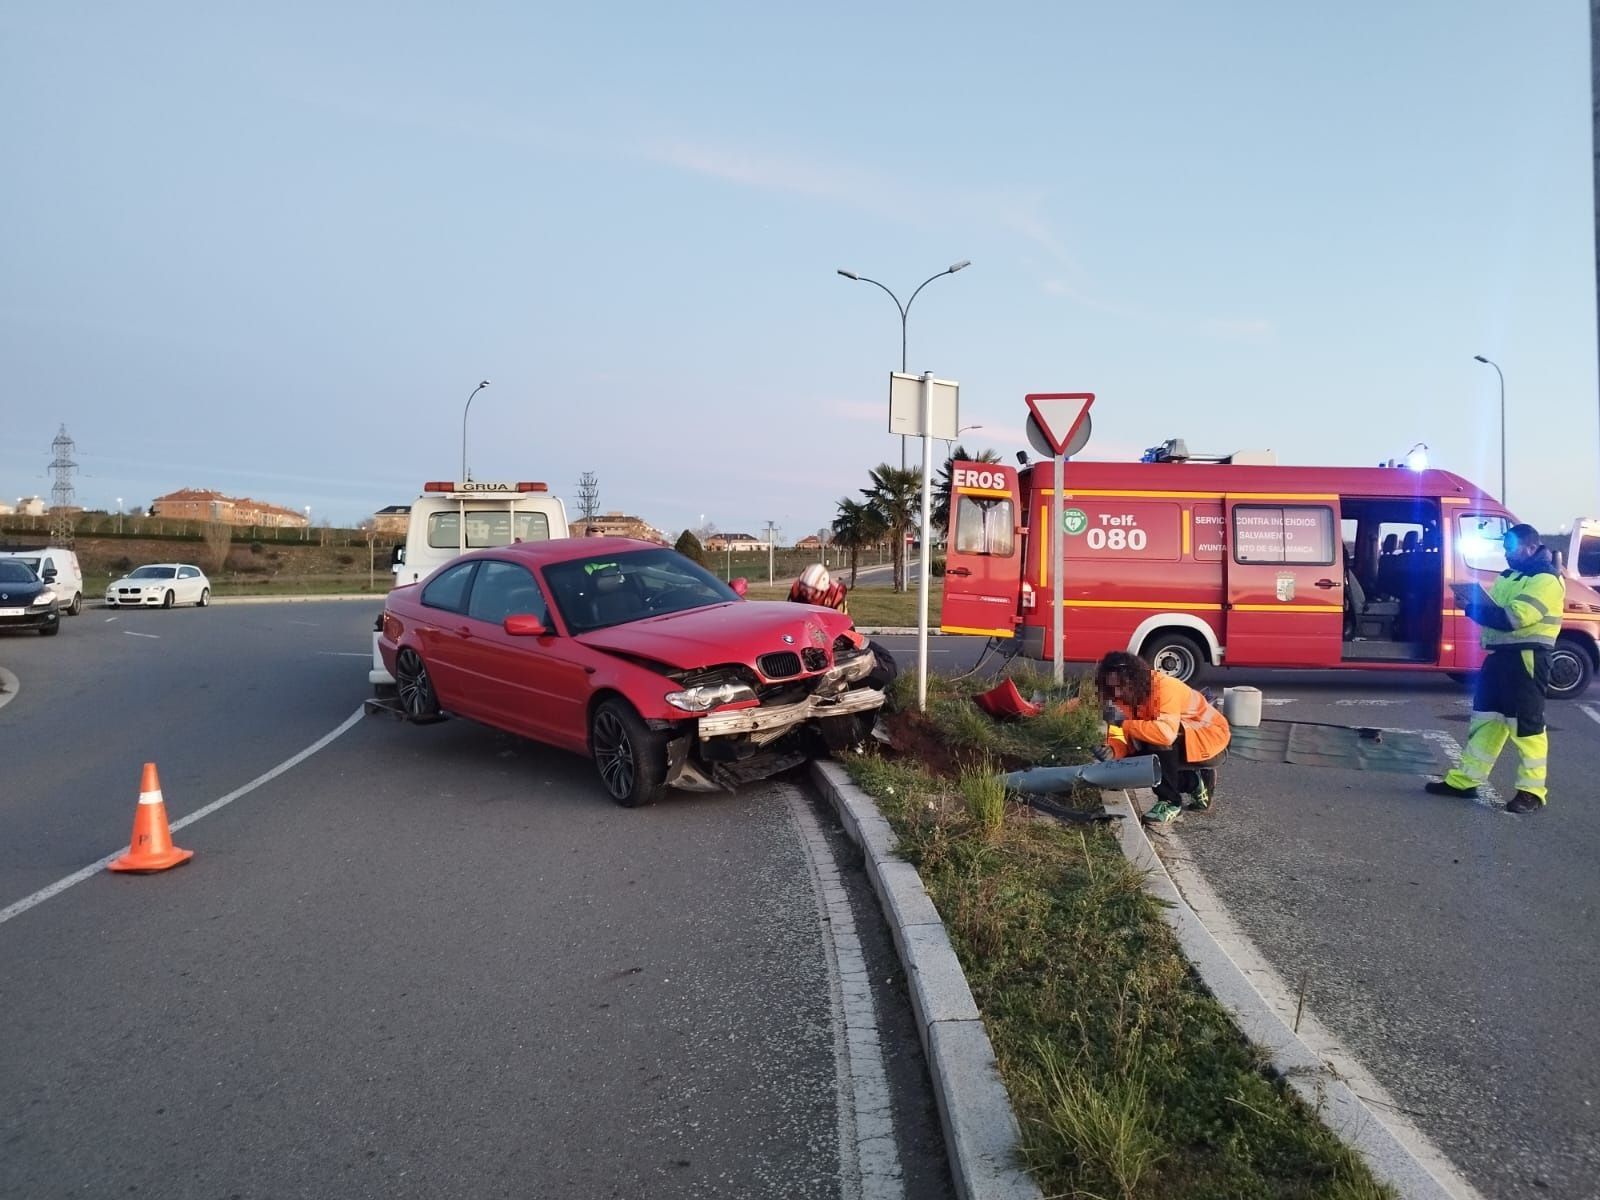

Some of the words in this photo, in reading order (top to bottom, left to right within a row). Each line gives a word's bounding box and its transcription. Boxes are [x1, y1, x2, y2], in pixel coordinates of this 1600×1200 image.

[953, 469, 1005, 490] EROS
[463, 483, 508, 491] GRUA
[1098, 514, 1137, 526] Telf.
[1236, 516, 1270, 525] CONTRA
[1271, 517, 1316, 527] INCENDIOS
[1087, 528, 1147, 550] 080
[1218, 530, 1224, 538] Y
